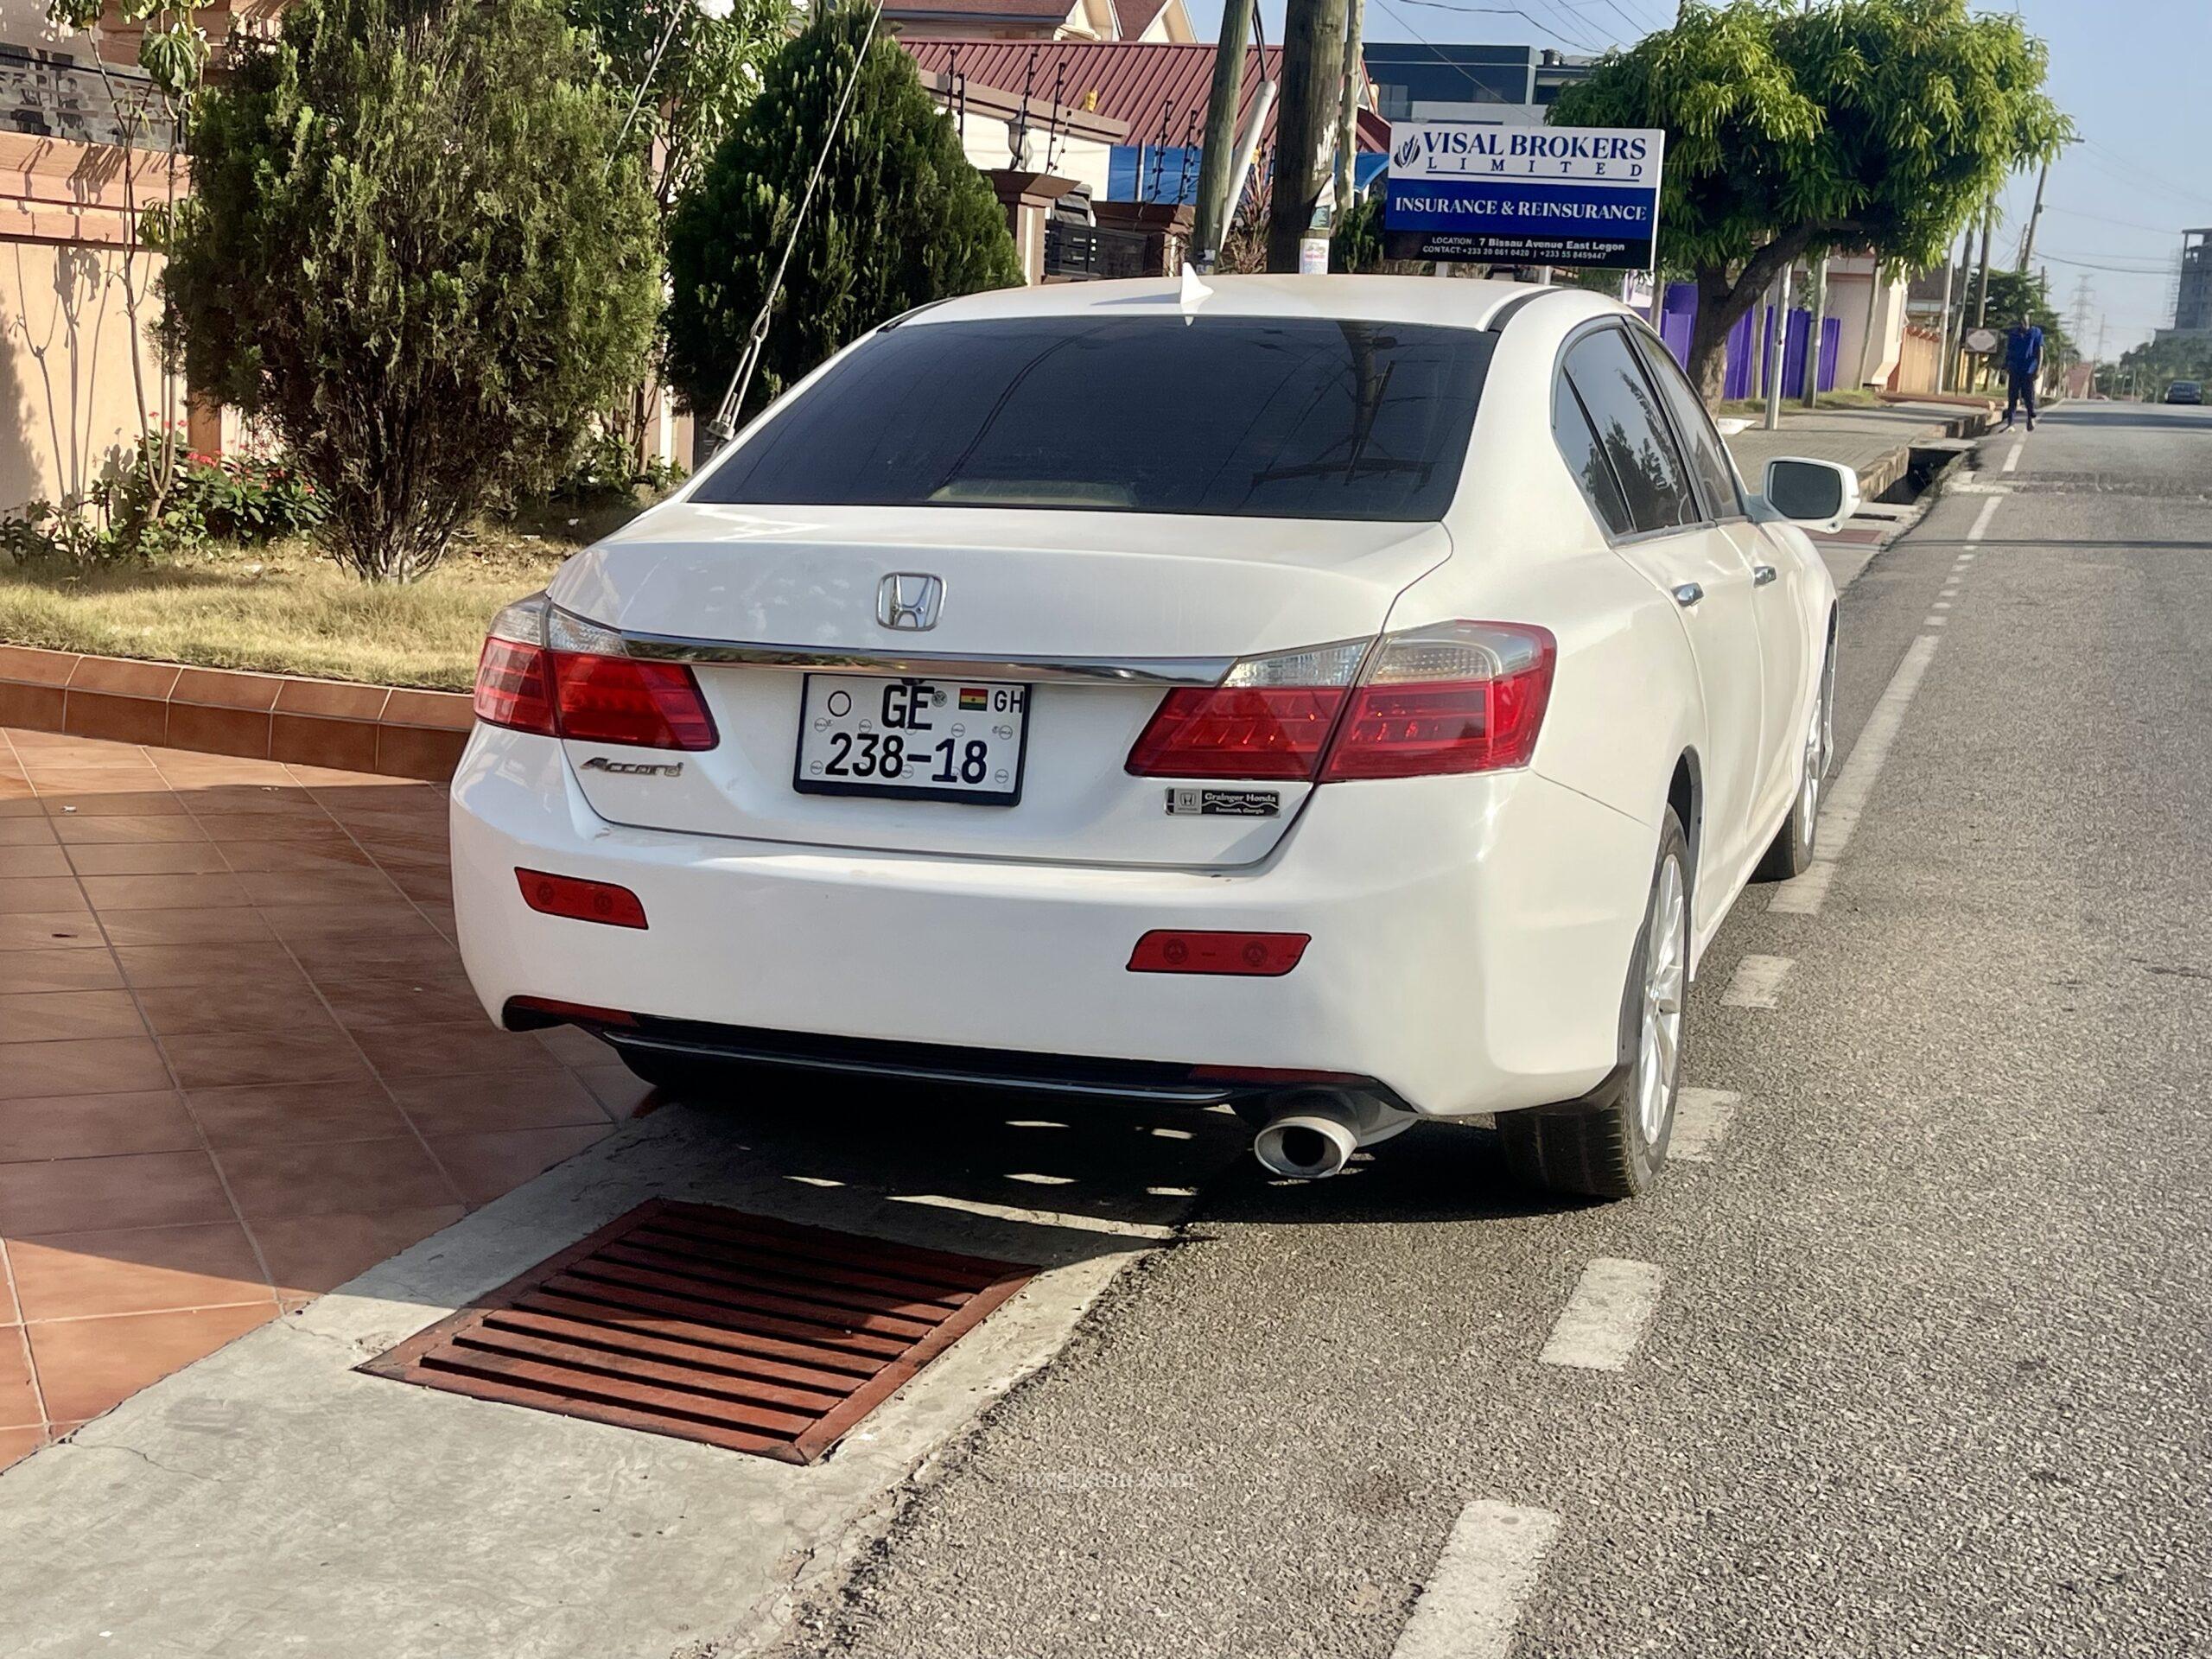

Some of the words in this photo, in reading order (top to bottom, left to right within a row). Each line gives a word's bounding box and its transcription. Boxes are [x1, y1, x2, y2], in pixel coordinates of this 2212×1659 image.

[1423, 131, 1504, 156] VISAL
[1510, 134, 1646, 160] BROKERS
[1427, 156, 1643, 176] LIMITED
[1395, 196, 1498, 215] INSURANCE
[1502, 201, 1515, 215] &
[1517, 201, 1648, 220] REINSURANCE
[1478, 238, 1486, 247] 7
[1488, 238, 1523, 247] Bissau
[1525, 239, 1564, 249] Avenue
[1566, 240, 1591, 251] East
[1592, 242, 1625, 252] Legon
[881, 684, 935, 730] GE
[994, 690, 1024, 714] GH
[824, 732, 988, 785] 238-18
[1205, 792, 1244, 803] Grainger
[1246, 793, 1276, 803] Honda
